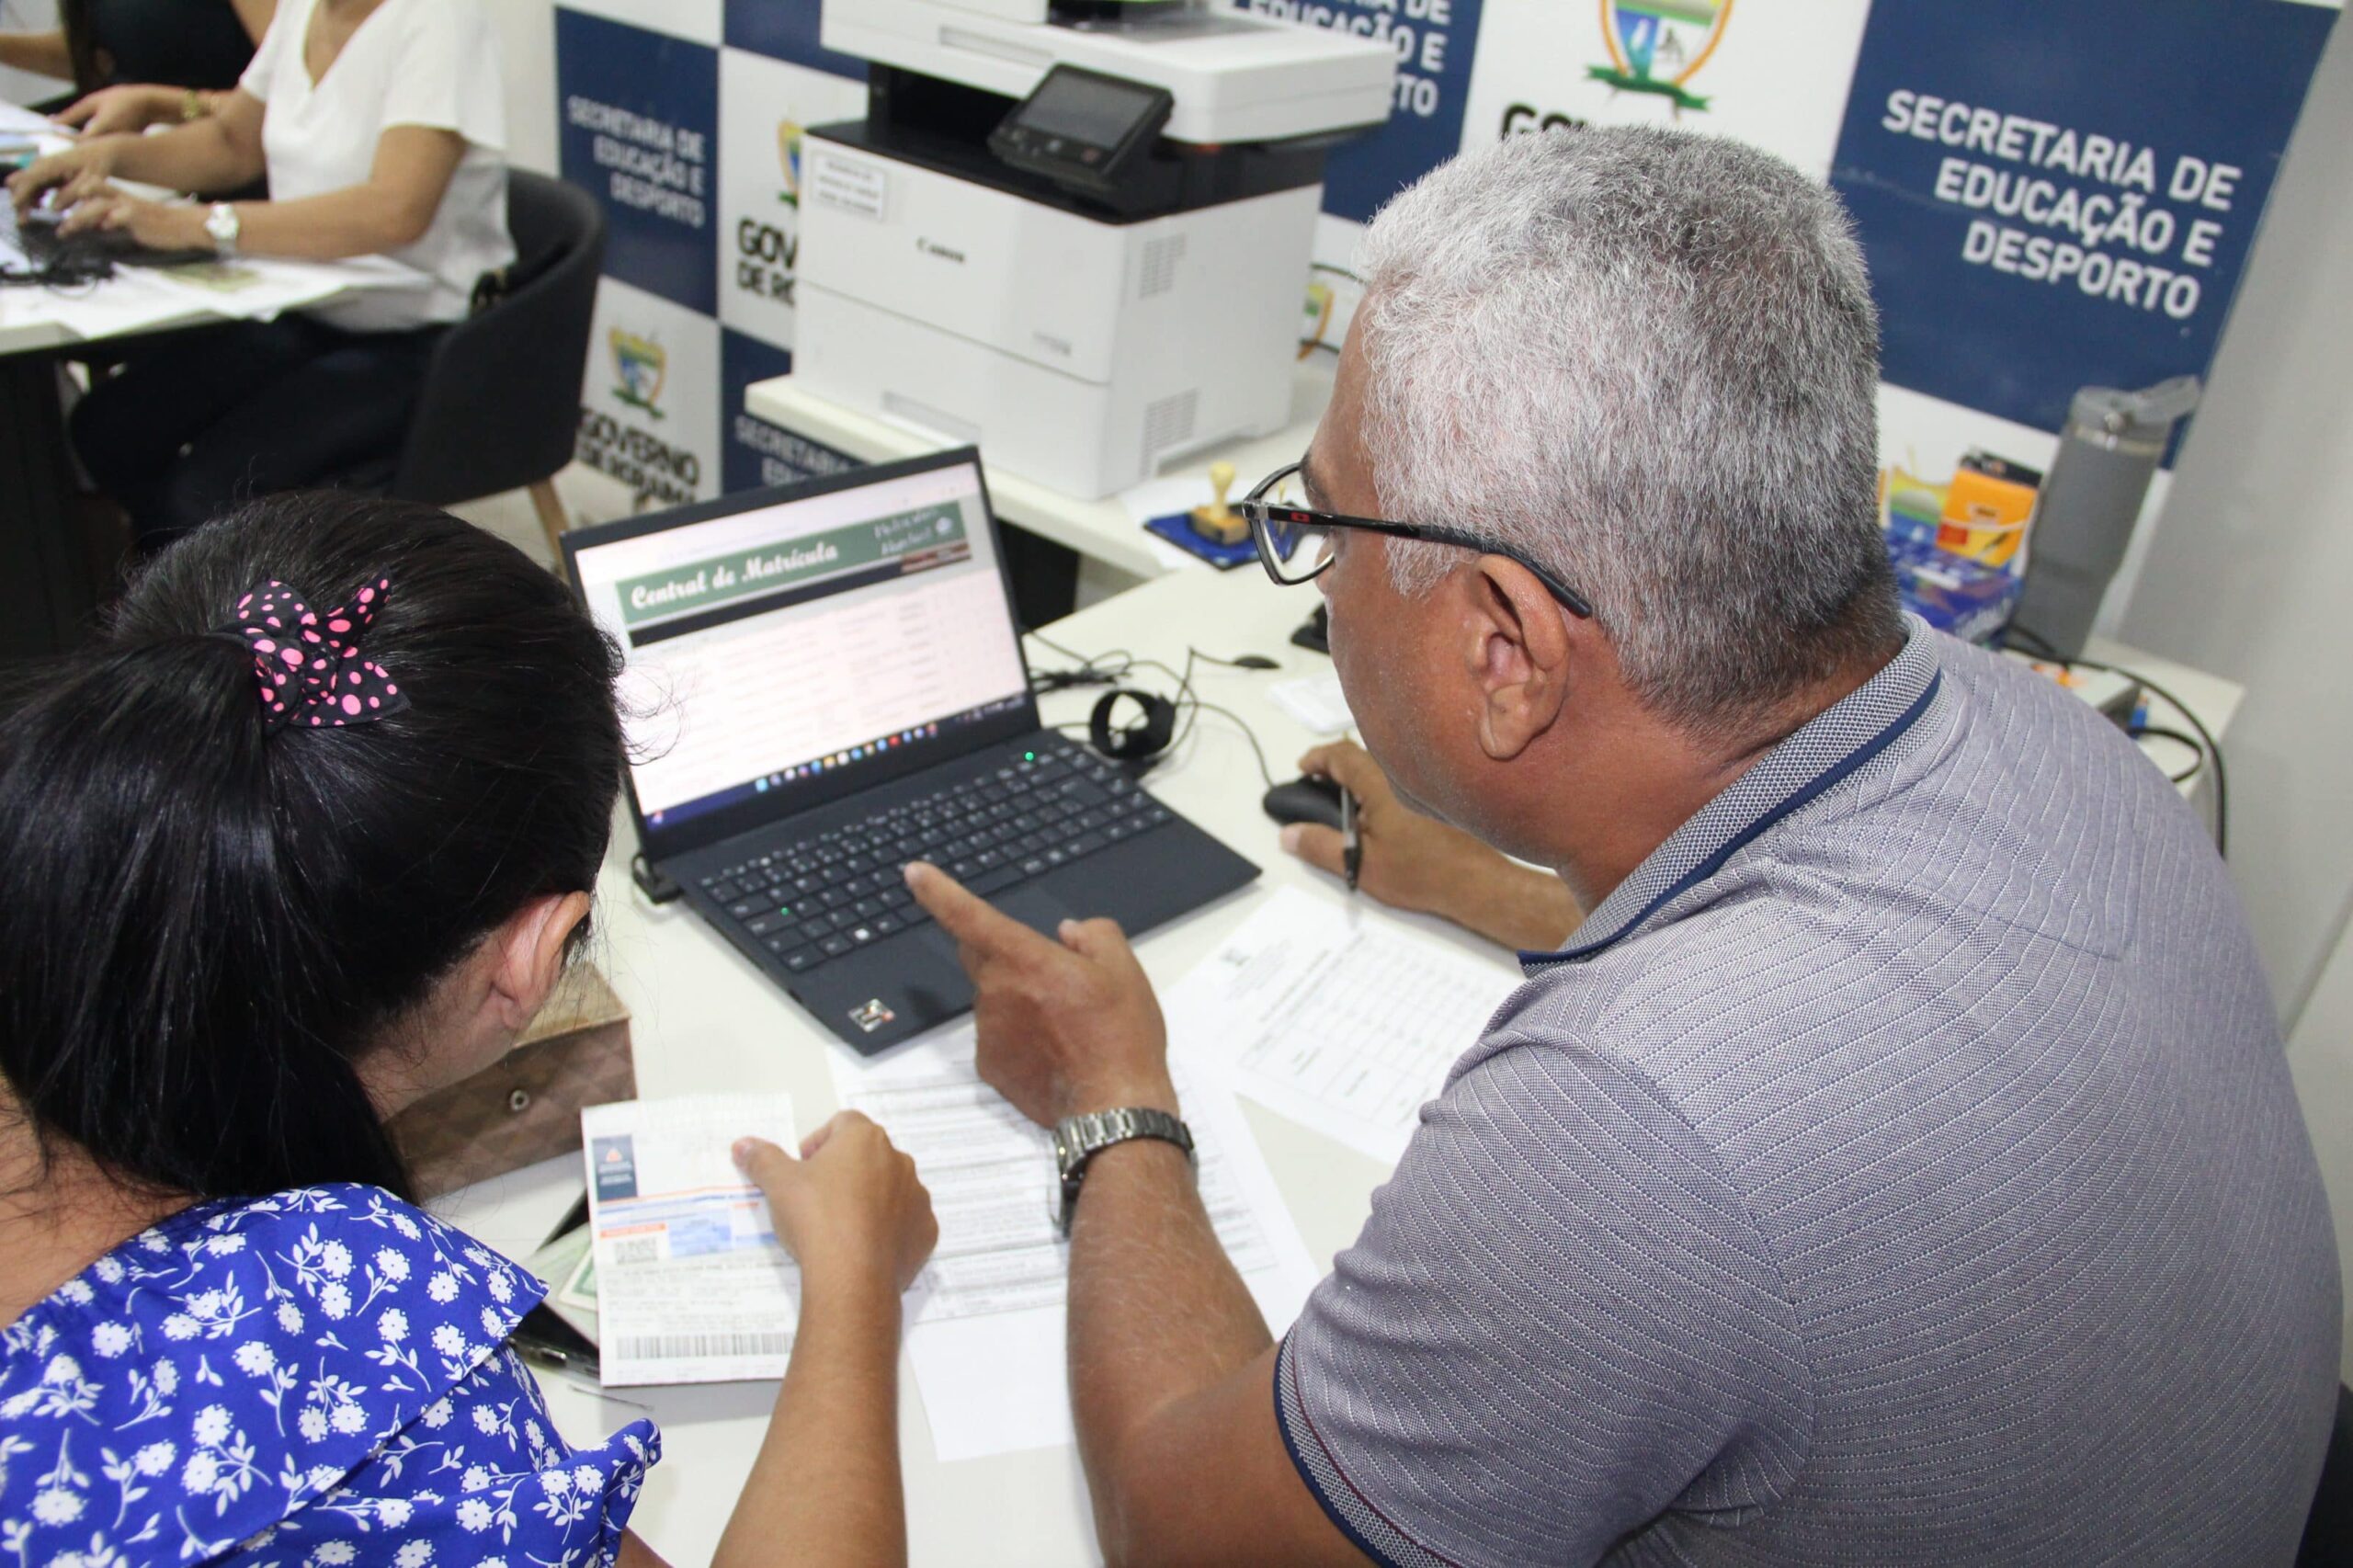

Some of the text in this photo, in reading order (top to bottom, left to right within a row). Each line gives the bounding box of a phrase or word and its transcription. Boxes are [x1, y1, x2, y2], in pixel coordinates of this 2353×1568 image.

[1420, 32, 1449, 73] E
[566, 95, 705, 164] SECRETARIA DE
[1881, 89, 2243, 211] SECRETARIA DE
[1934, 157, 2223, 267] EDUCAÇÃO E
[1961, 220, 2201, 319] DESPORTO
[631, 567, 707, 610] Central
[712, 563, 734, 590] de
[741, 540, 840, 583] Matrícula
